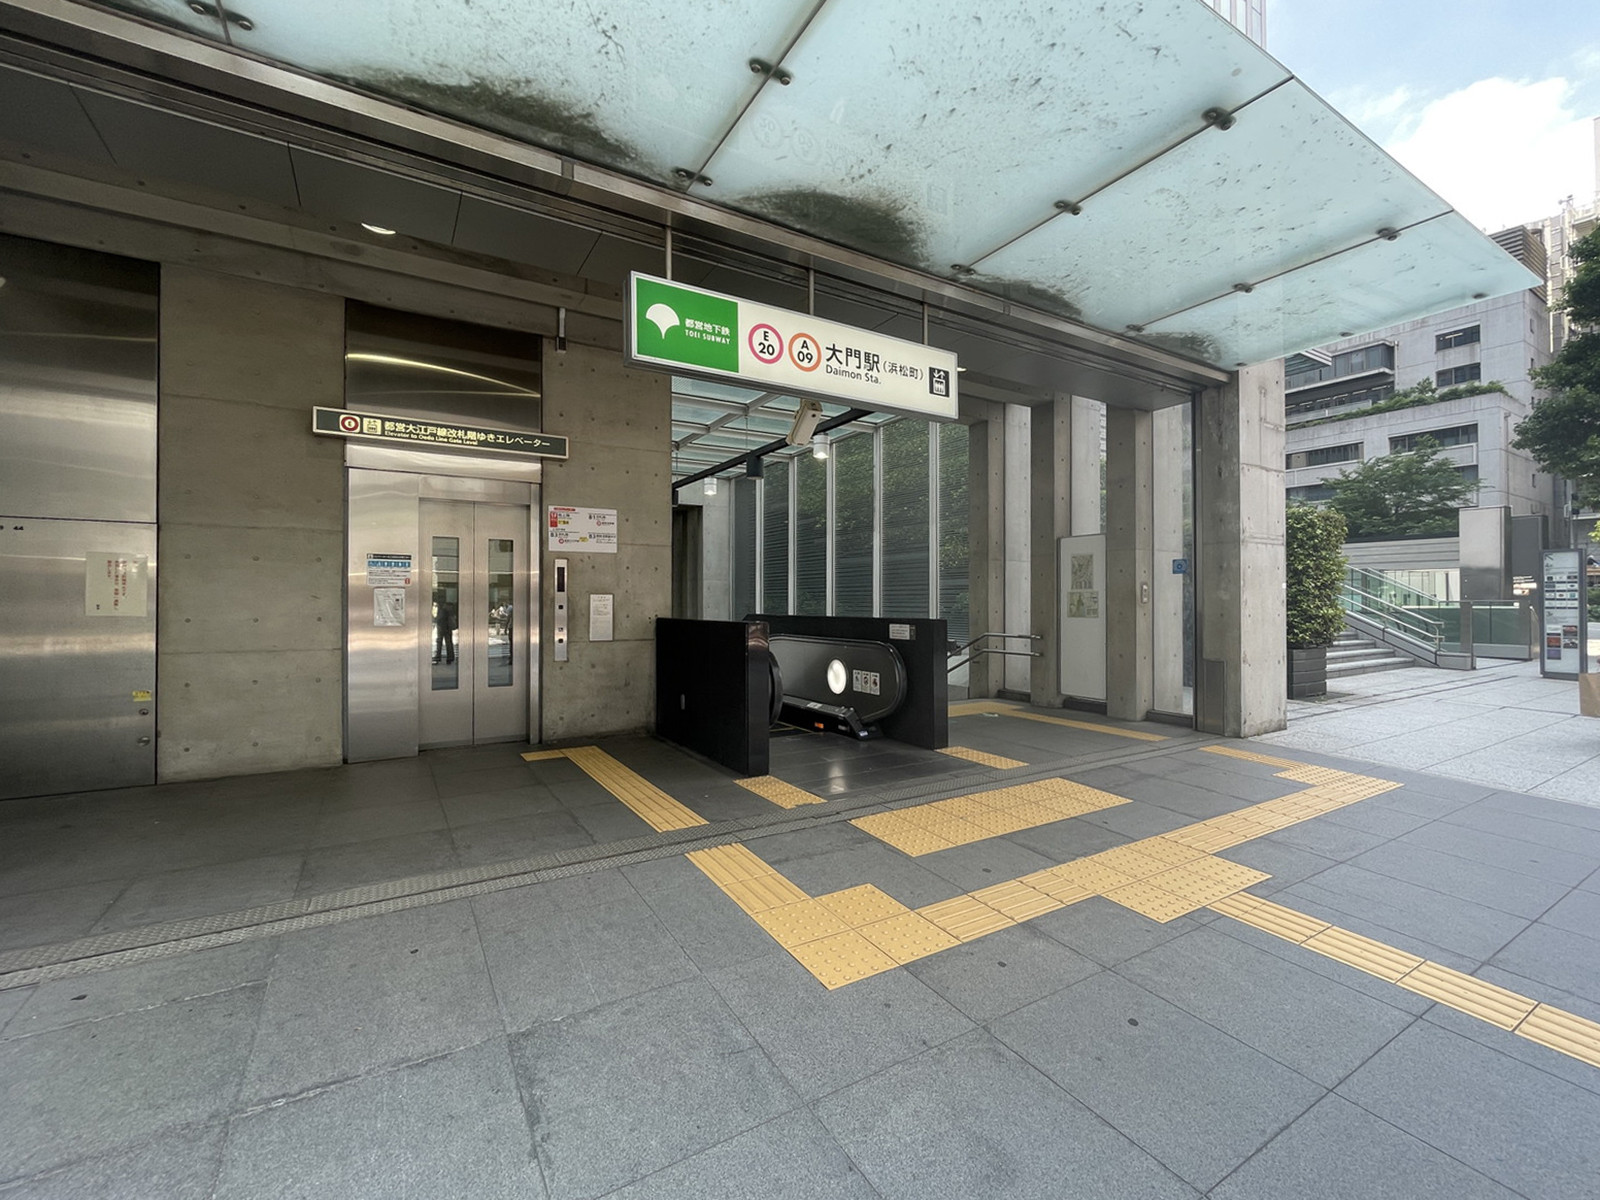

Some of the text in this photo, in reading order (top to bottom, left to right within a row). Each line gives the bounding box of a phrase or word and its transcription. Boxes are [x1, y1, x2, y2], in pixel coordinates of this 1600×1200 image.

[685, 318, 731, 337] 都営地下鉄
[685, 329, 731, 345] TOEI SUBWAY
[763, 330, 770, 342] E
[758, 341, 776, 356] 20
[801, 339, 809, 351] A
[797, 350, 814, 364] 09
[825, 364, 882, 385] Daimon Sta.
[384, 430, 410, 439] Elevator
[418, 434, 435, 442] Oedo
[435, 435, 448, 443] Line
[448, 437, 463, 445] Gate
